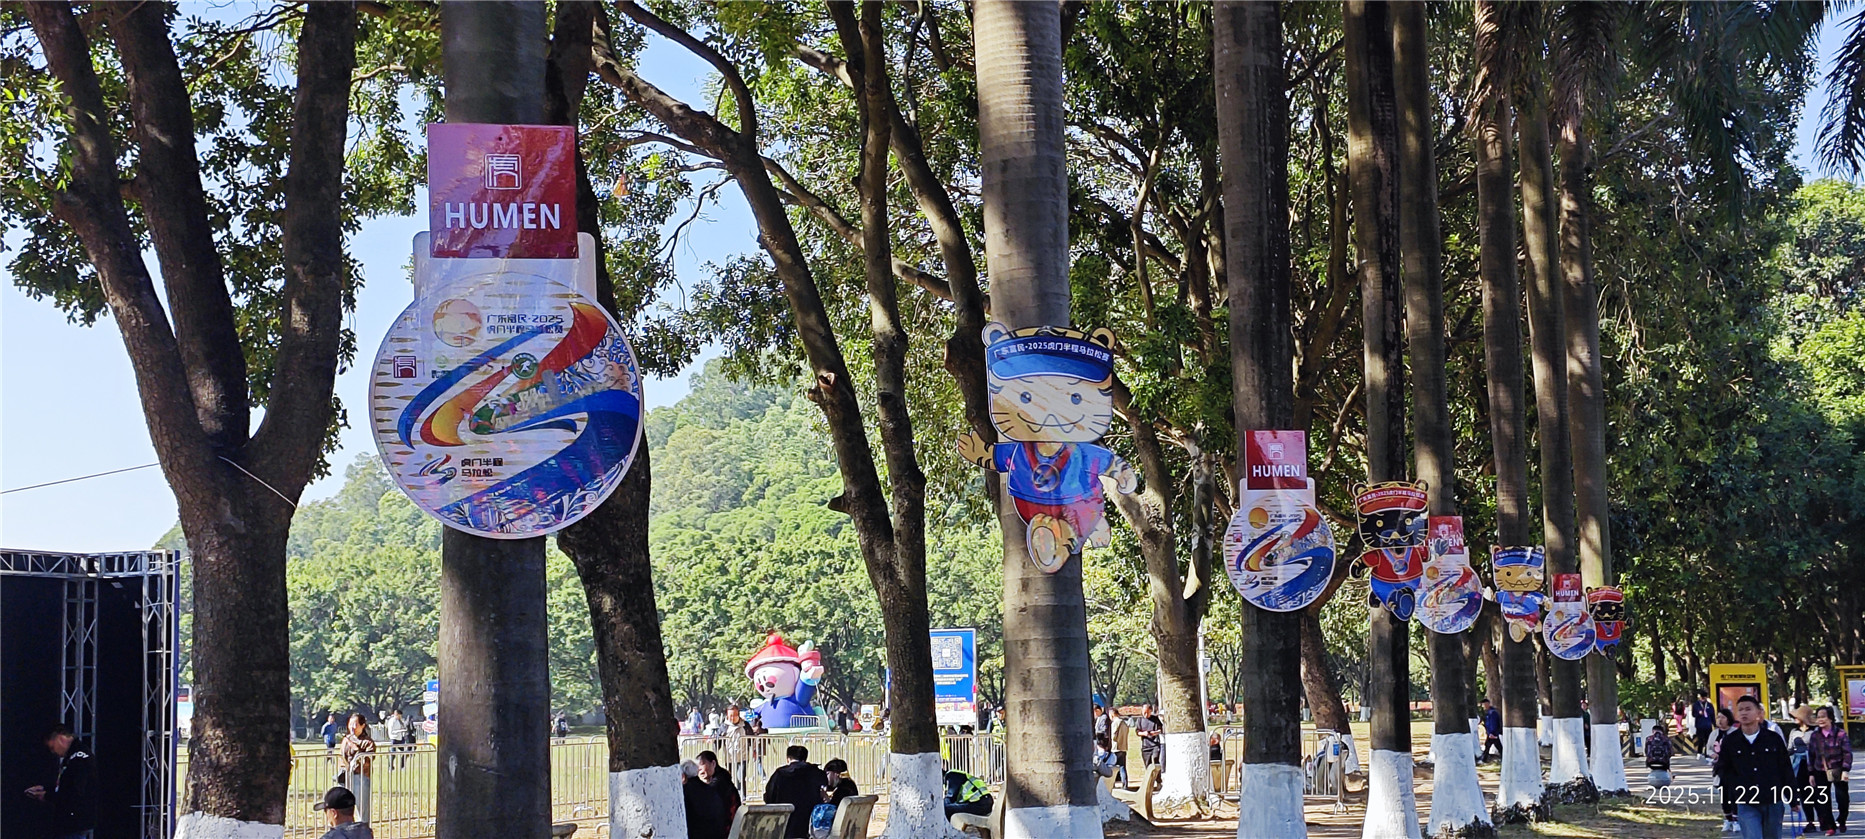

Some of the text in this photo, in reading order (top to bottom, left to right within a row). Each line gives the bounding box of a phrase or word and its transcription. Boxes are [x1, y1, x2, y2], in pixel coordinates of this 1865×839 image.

[445, 202, 560, 229] HUMEN
[1252, 464, 1300, 477] HUMEN
[1428, 537, 1460, 547] HEN
[1555, 589, 1579, 597] HUMEN
